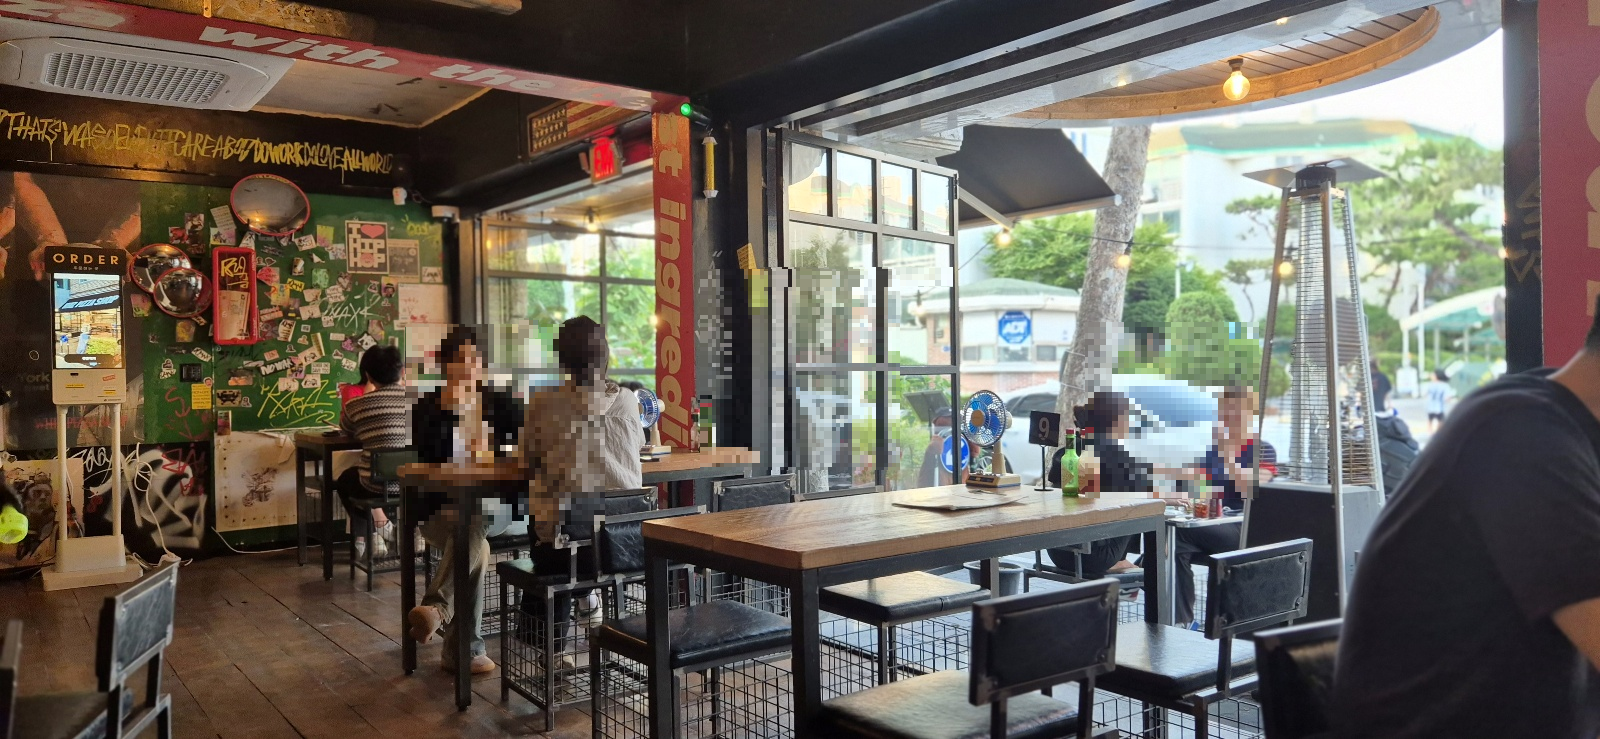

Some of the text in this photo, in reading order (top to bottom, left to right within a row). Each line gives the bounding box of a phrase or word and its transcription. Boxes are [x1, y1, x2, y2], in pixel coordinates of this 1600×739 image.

[198, 26, 401, 71] with
[429, 63, 556, 94] the
[349, 238, 385, 254] HIP
[52, 253, 119, 265] ORDER
[655, 196, 689, 447] ingredi
[1038, 417, 1050, 441] 9
